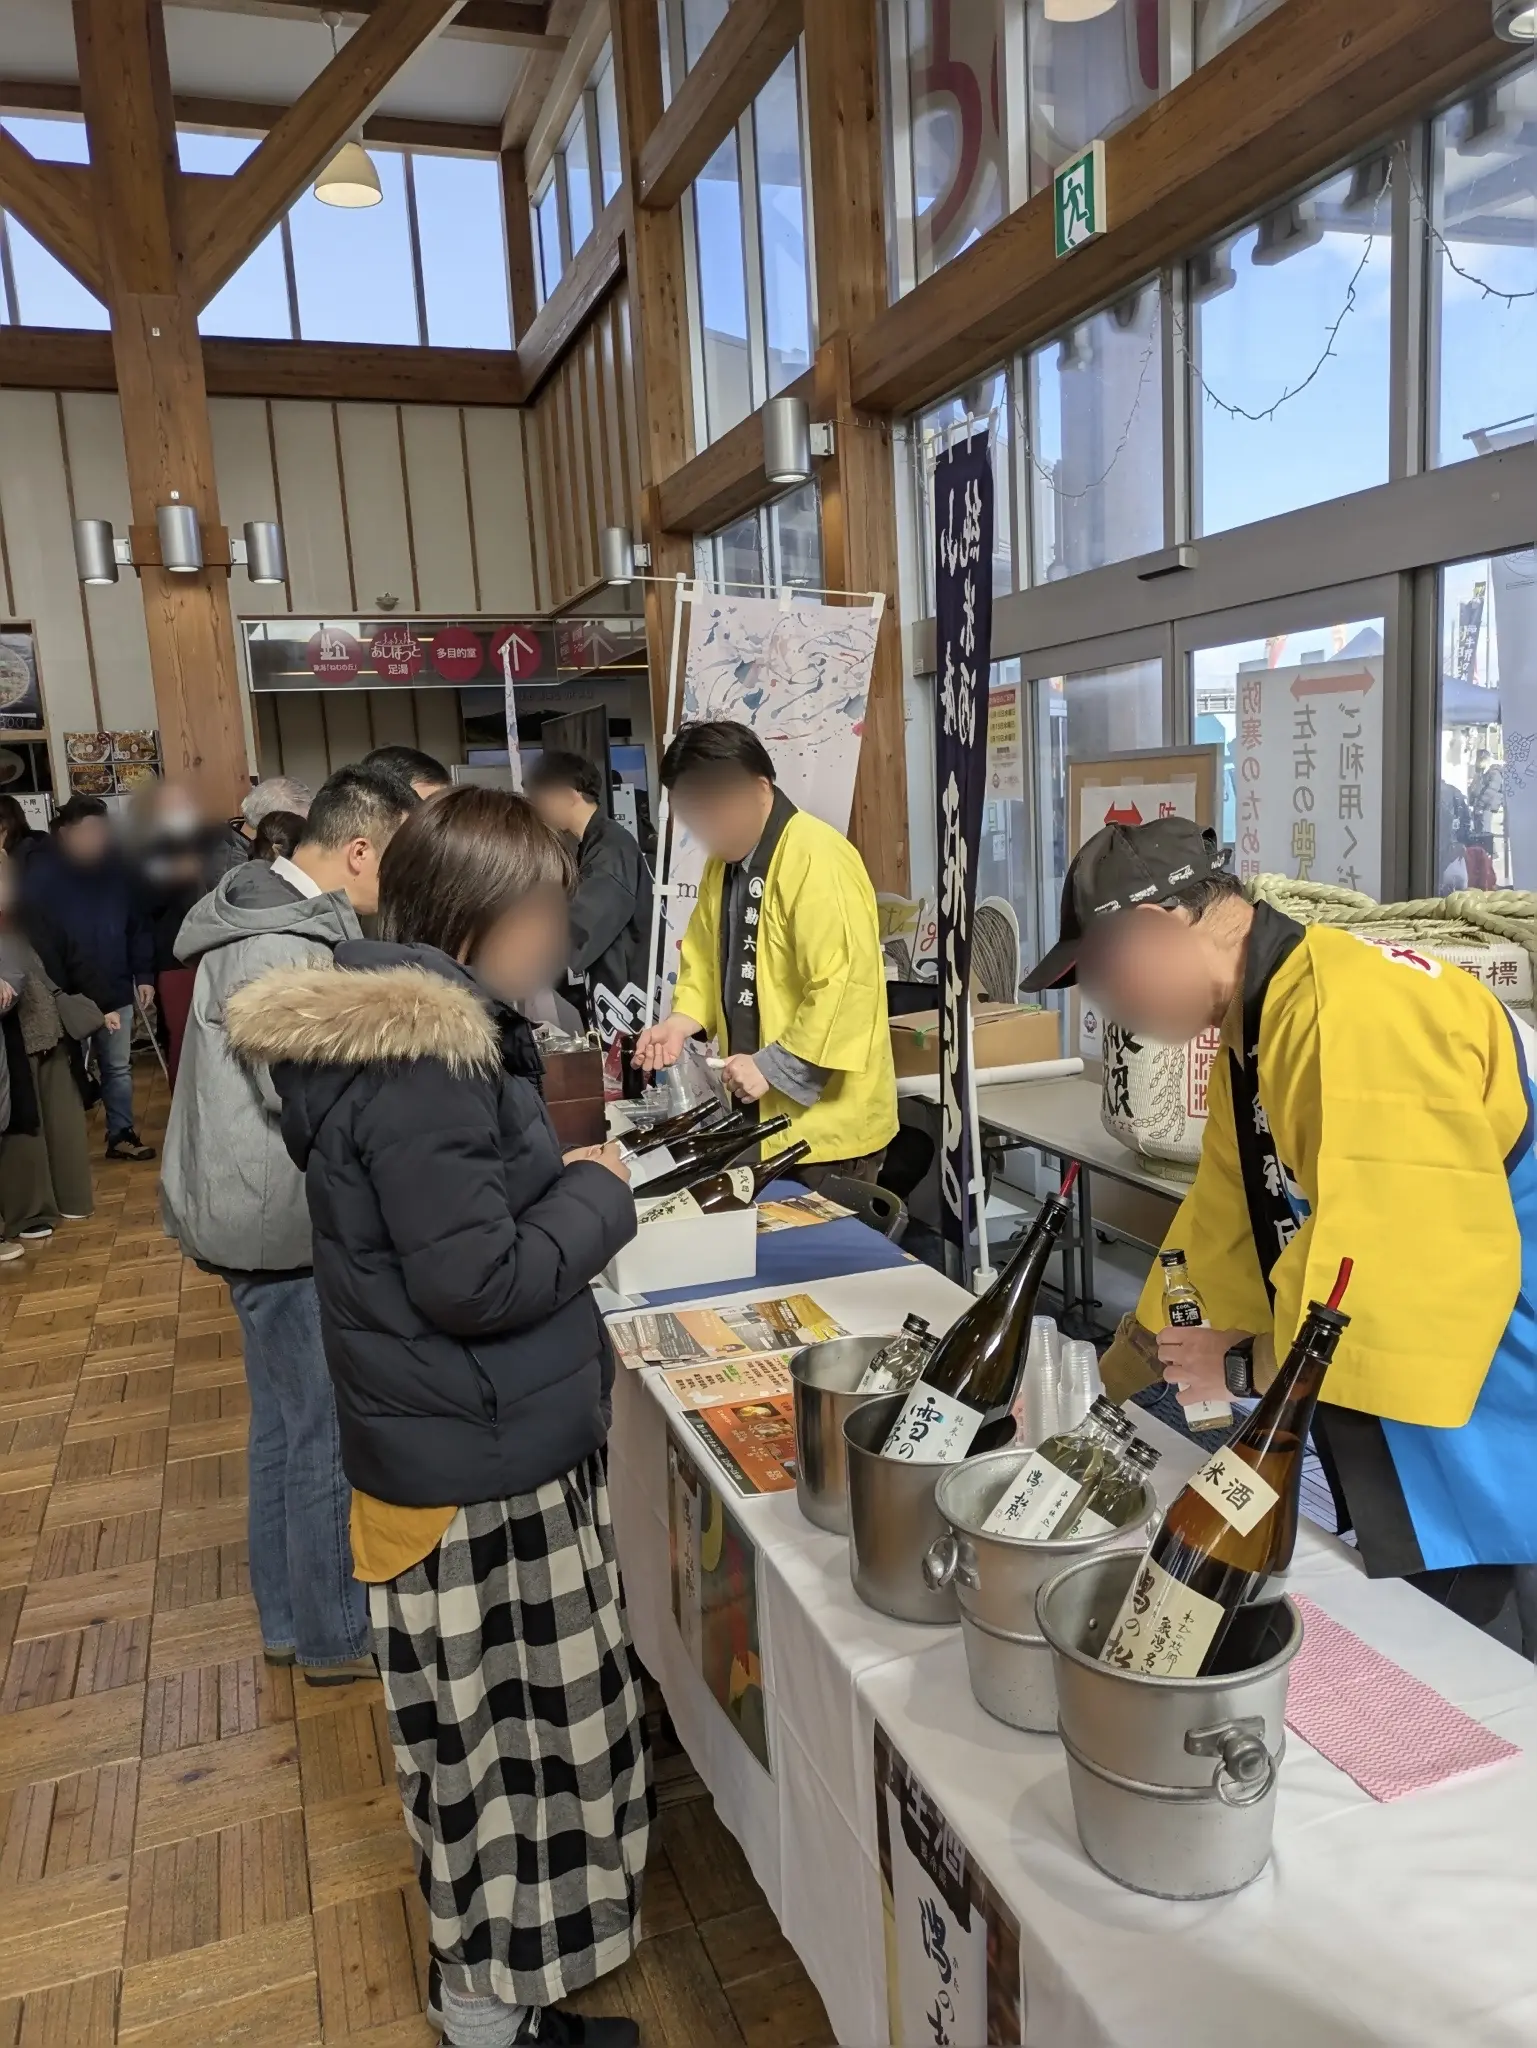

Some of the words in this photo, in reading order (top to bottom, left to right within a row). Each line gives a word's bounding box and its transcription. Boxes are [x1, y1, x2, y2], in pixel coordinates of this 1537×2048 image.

[388, 664, 409, 675] 足湯
[436, 647, 477, 659] 多目的室
[738, 906, 760, 1007] 勘六商店
[1171, 1308, 1200, 1324] 生酒
[897, 1396, 944, 1459] 雪の
[937, 1414, 964, 1460] 純米吟醸
[1197, 1459, 1255, 1512] 米酒
